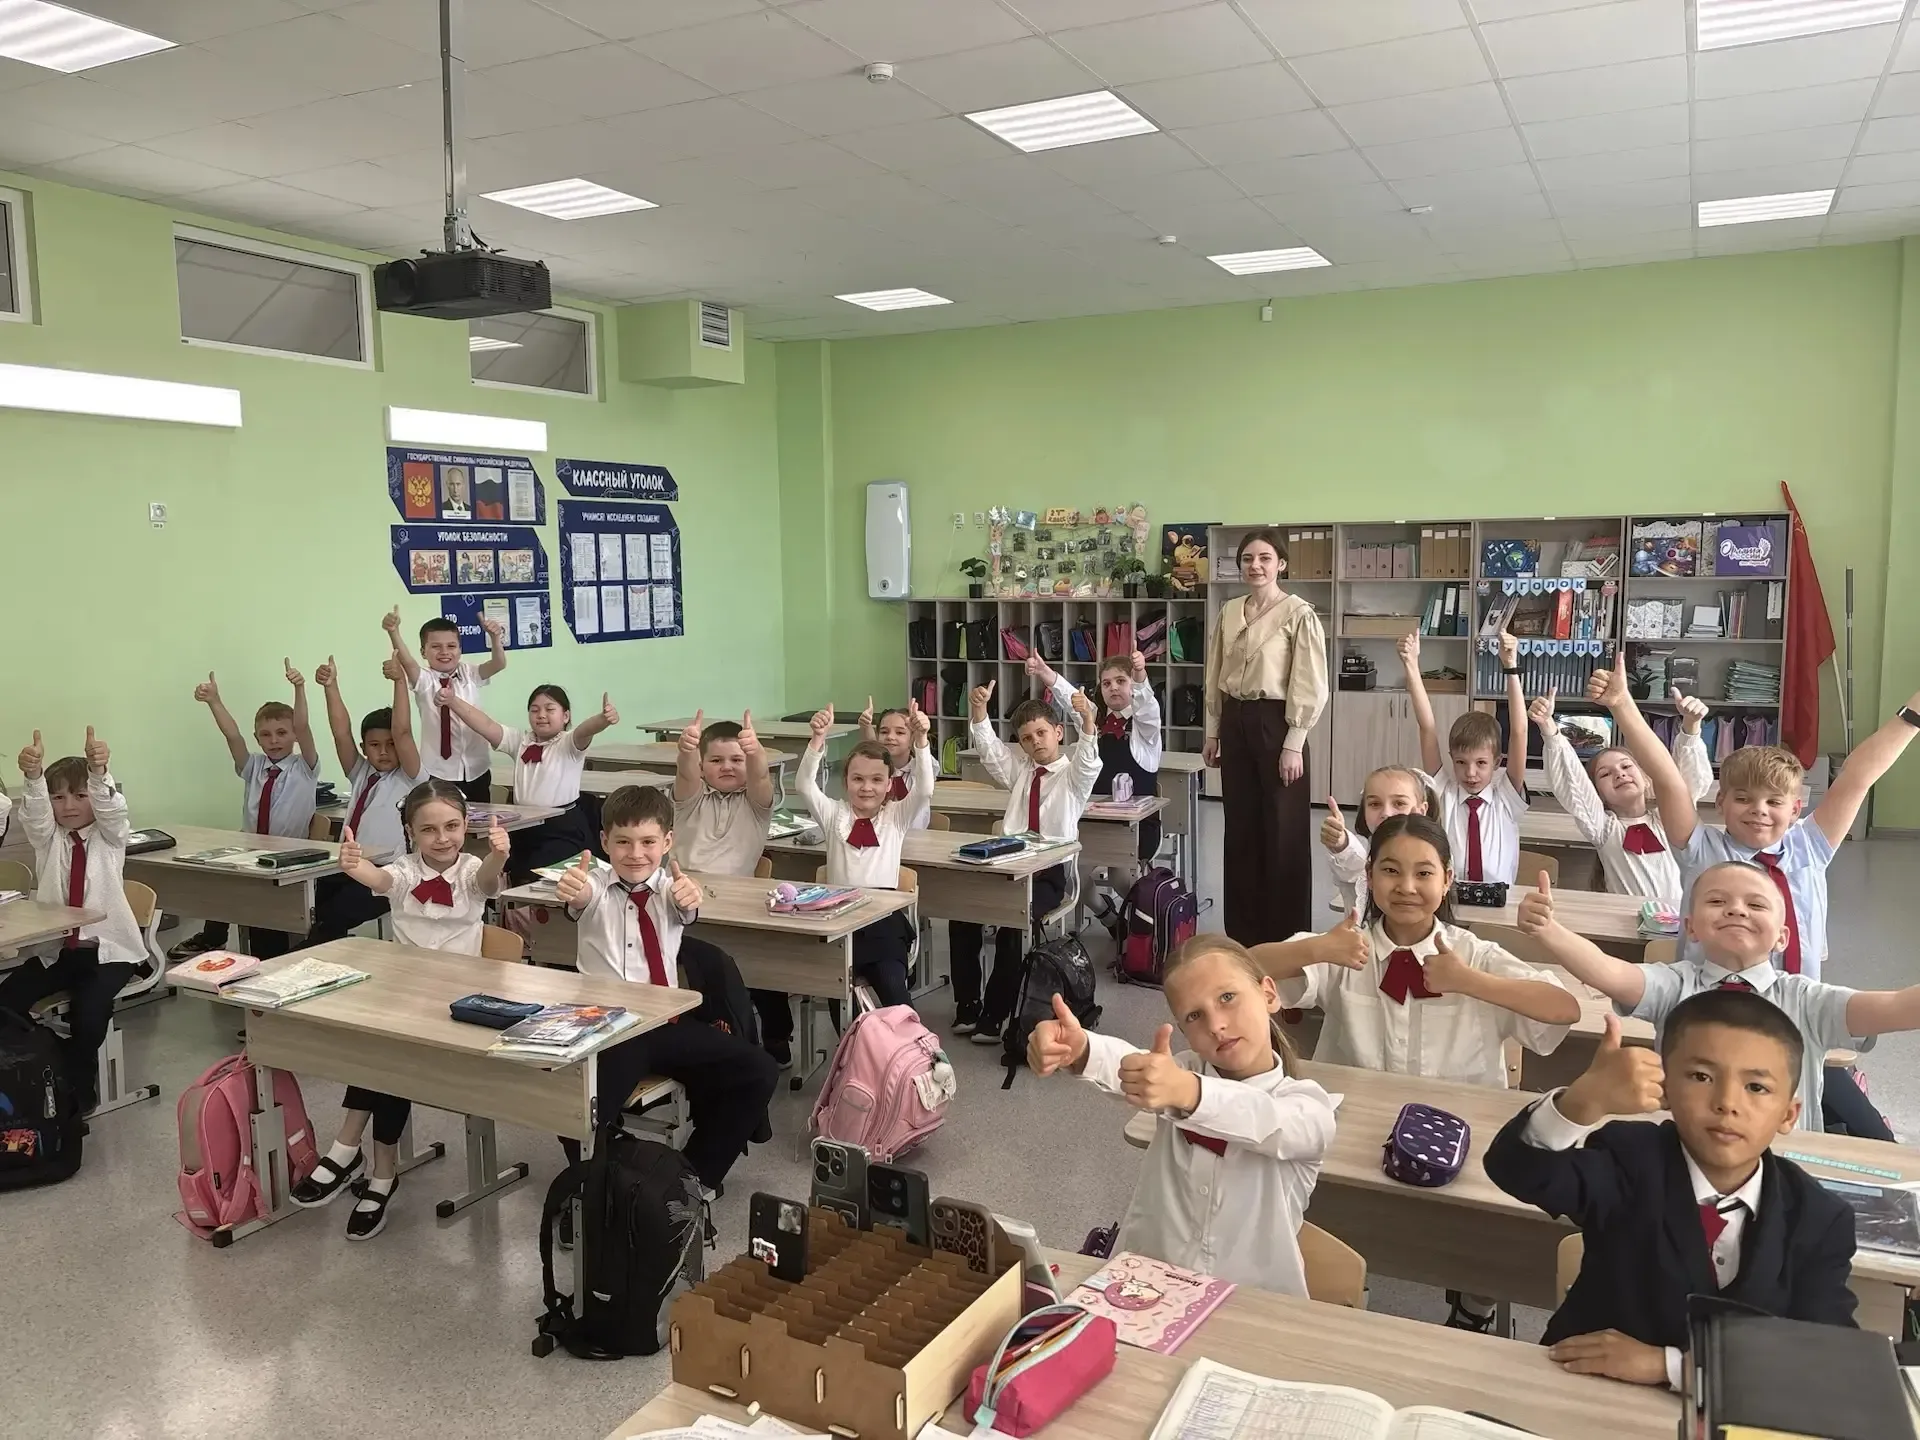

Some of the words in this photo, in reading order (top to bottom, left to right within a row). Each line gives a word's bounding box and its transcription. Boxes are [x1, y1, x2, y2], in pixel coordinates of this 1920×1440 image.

[572, 469, 629, 489] КЛАССНЫЙ
[630, 472, 665, 492] УГОЛОК
[437, 532, 461, 542] УГОЛОК
[461, 532, 509, 542] БЕЗОПАСНОСТИ
[1505, 580, 1584, 591] УГОЛОК
[1491, 642, 1600, 652] ЧТАТЕЛЯ
